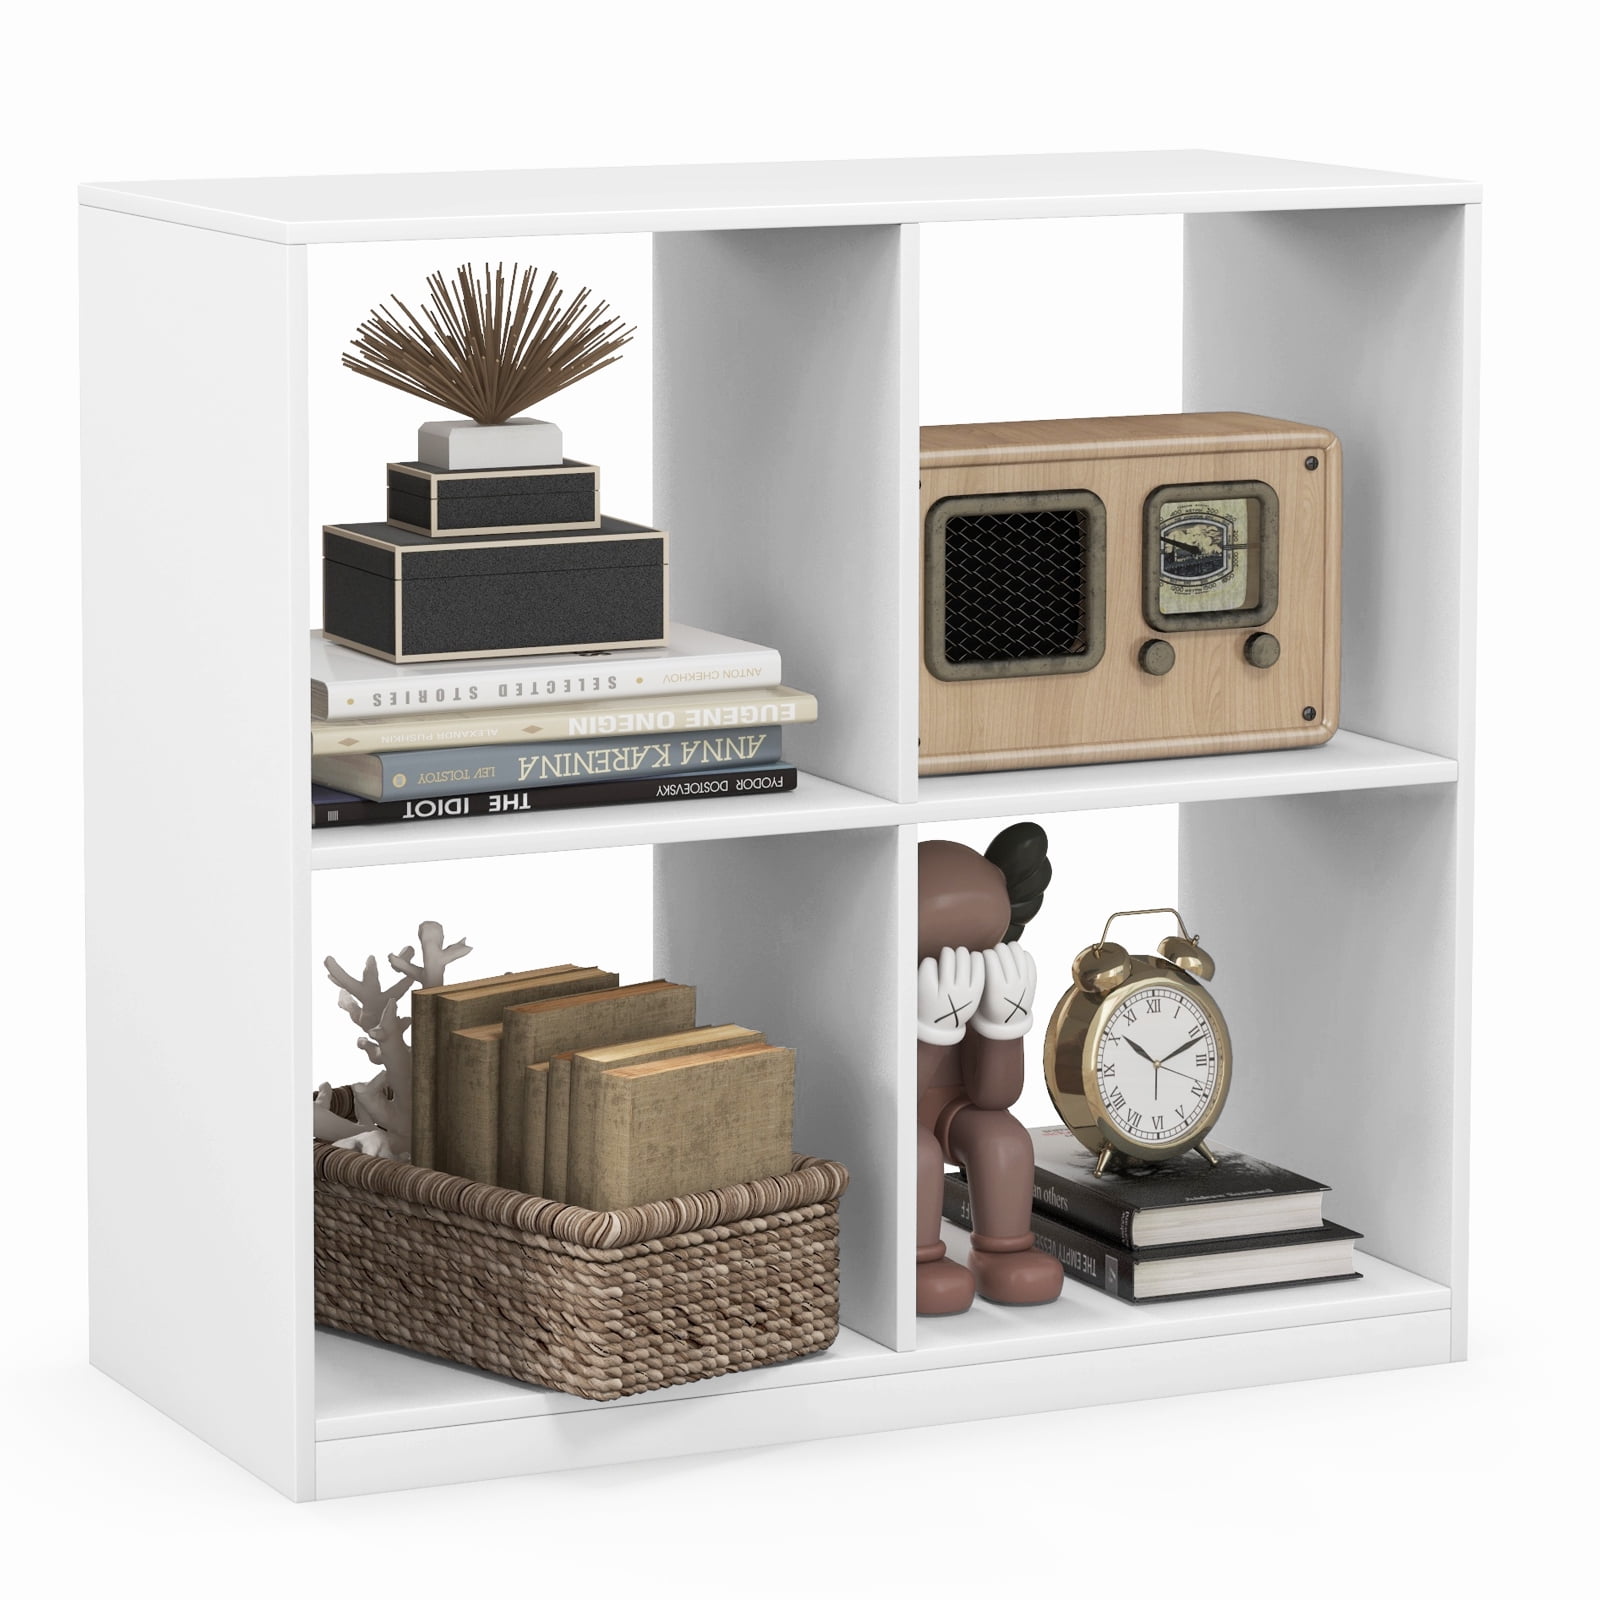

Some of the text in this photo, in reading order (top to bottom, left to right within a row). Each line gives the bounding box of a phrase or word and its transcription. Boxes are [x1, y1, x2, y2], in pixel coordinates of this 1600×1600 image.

[663, 667, 763, 684] ANTON CHEKHOV
[372, 675, 617, 707] SELECTED STORIES
[568, 702, 796, 736] EUGENE ONEGIN
[381, 728, 499, 744] ALEXANDR PUSHKIN
[518, 734, 767, 781] ANNA KARENINA
[417, 766, 496, 784] LEV TOLSTOY
[656, 775, 784, 797] FYODOR DOSTOEVSKY
[402, 792, 531, 819] THE IDIOT
[1146, 998, 1161, 1014] XII
[1123, 1008, 1137, 1026] XI
[1108, 1032, 1121, 1046] X
[1103, 1063, 1115, 1077] IX
[1126, 1108, 1142, 1128] VII
[1152, 1115, 1164, 1130] VI
[1043, 1186, 1069, 1212] others
[1058, 1244, 1081, 1270] EMPTY
[1082, 1255, 1097, 1277] THE
